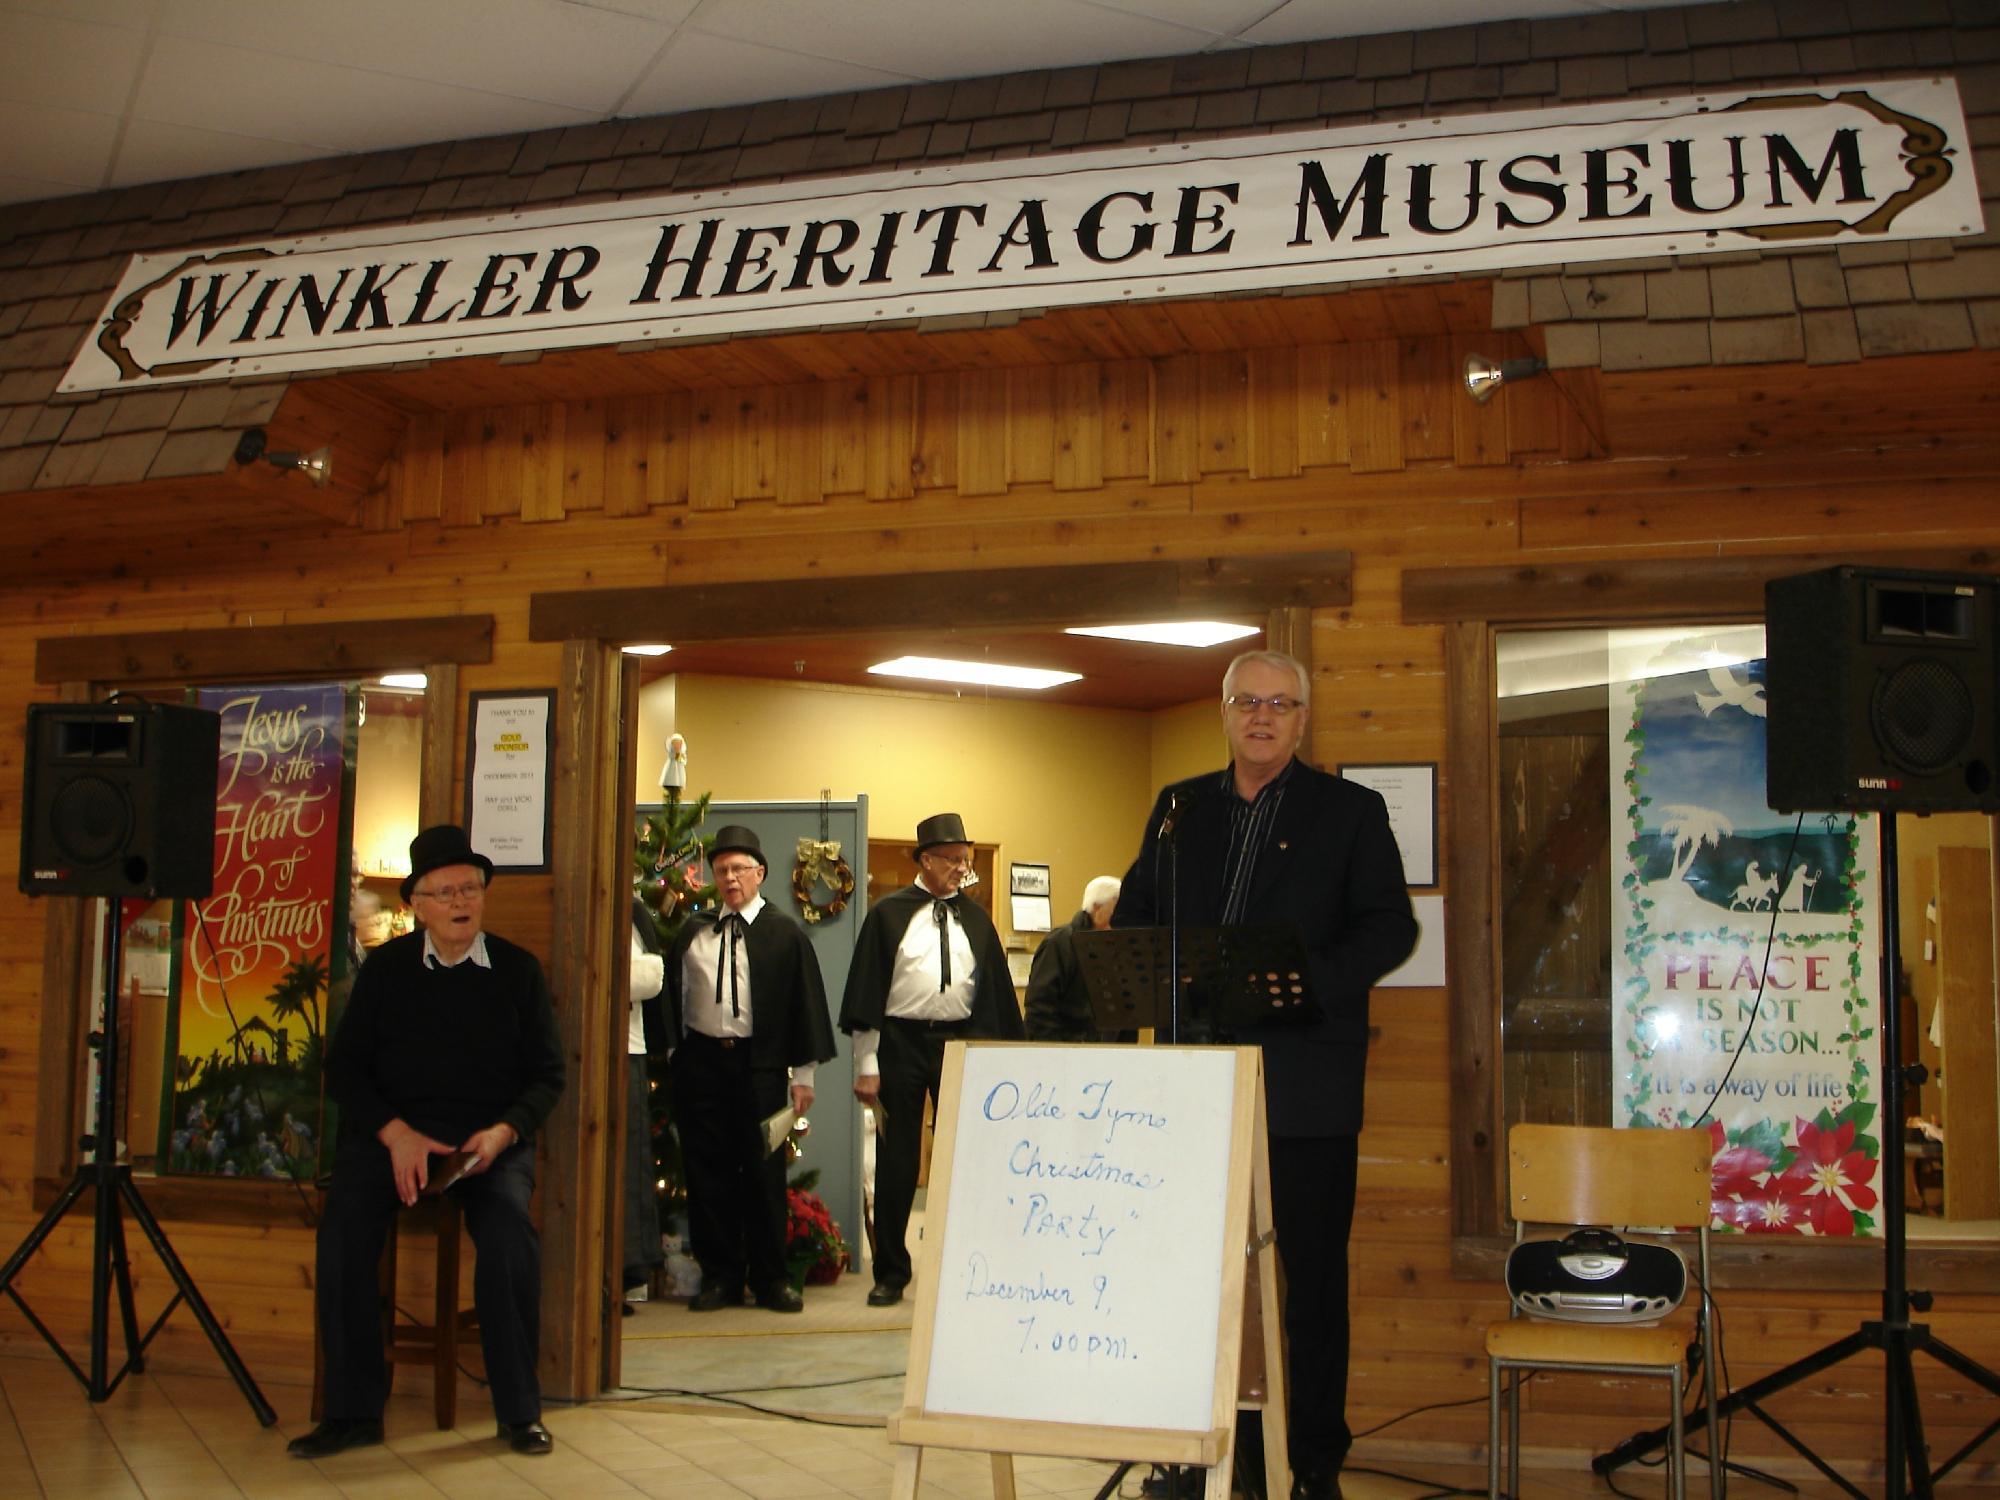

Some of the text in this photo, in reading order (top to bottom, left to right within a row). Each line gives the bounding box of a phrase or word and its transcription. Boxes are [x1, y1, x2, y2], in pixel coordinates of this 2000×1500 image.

[166, 127, 1876, 350] WINKLER HERITAGE MUSEUM
[216, 694, 308, 801] Jesus
[270, 727, 325, 784] is the
[493, 743, 529, 752] SPONSOR
[500, 734, 521, 742] GOLD
[1858, 778, 1888, 789] sunn
[213, 784, 331, 879] Heart
[270, 845, 311, 892] of
[189, 864, 329, 982] Christmas
[1664, 953, 1831, 993] PEACE
[1696, 997, 1802, 1023] IS NOT
[983, 1081, 1066, 1121] Olde
[1703, 1079, 1717, 1095] a
[1724, 1079, 1770, 1102] way
[1774, 1072, 1800, 1097] of
[1806, 1073, 1843, 1098] life
[966, 1252, 1074, 1306] December
